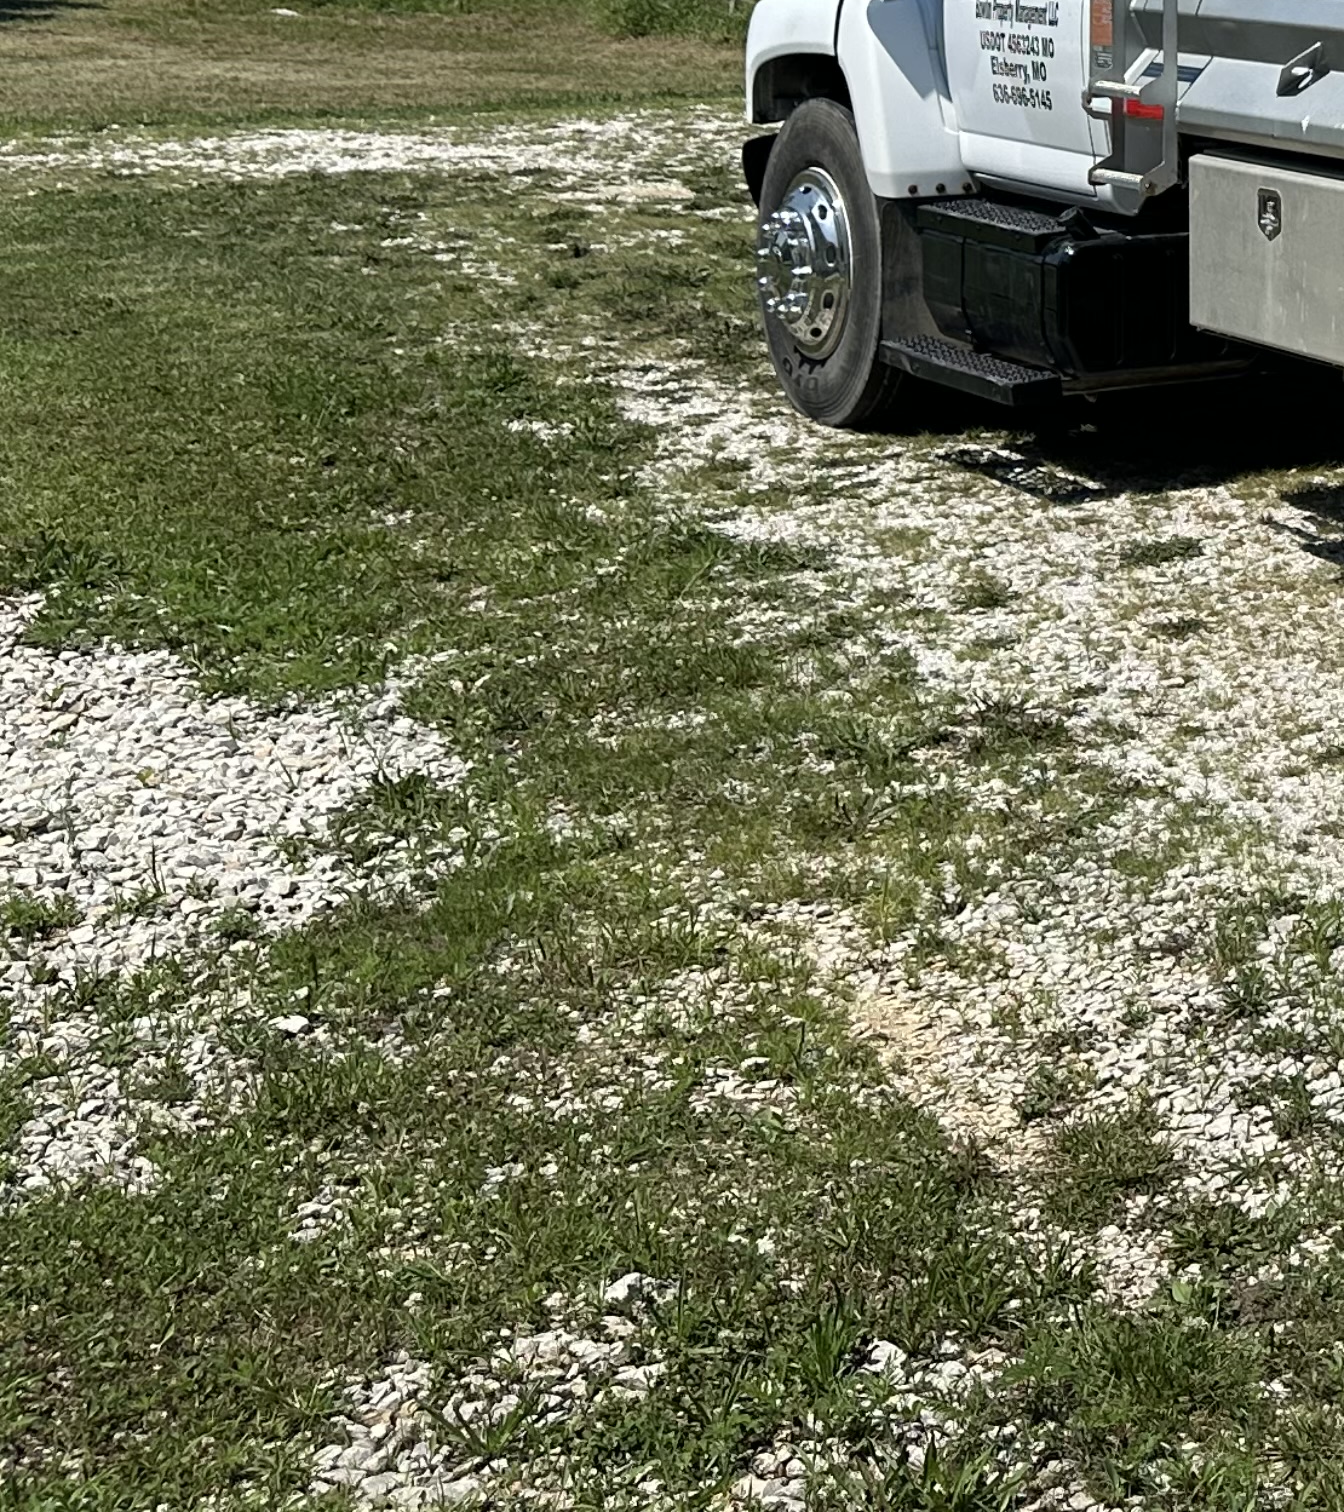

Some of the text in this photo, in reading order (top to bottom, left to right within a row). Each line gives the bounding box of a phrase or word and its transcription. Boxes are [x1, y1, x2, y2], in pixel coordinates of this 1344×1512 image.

[980, 30, 1005, 52] USDOT
[1042, 37, 1055, 58] MO
[990, 56, 1047, 85] Elsberry, MO
